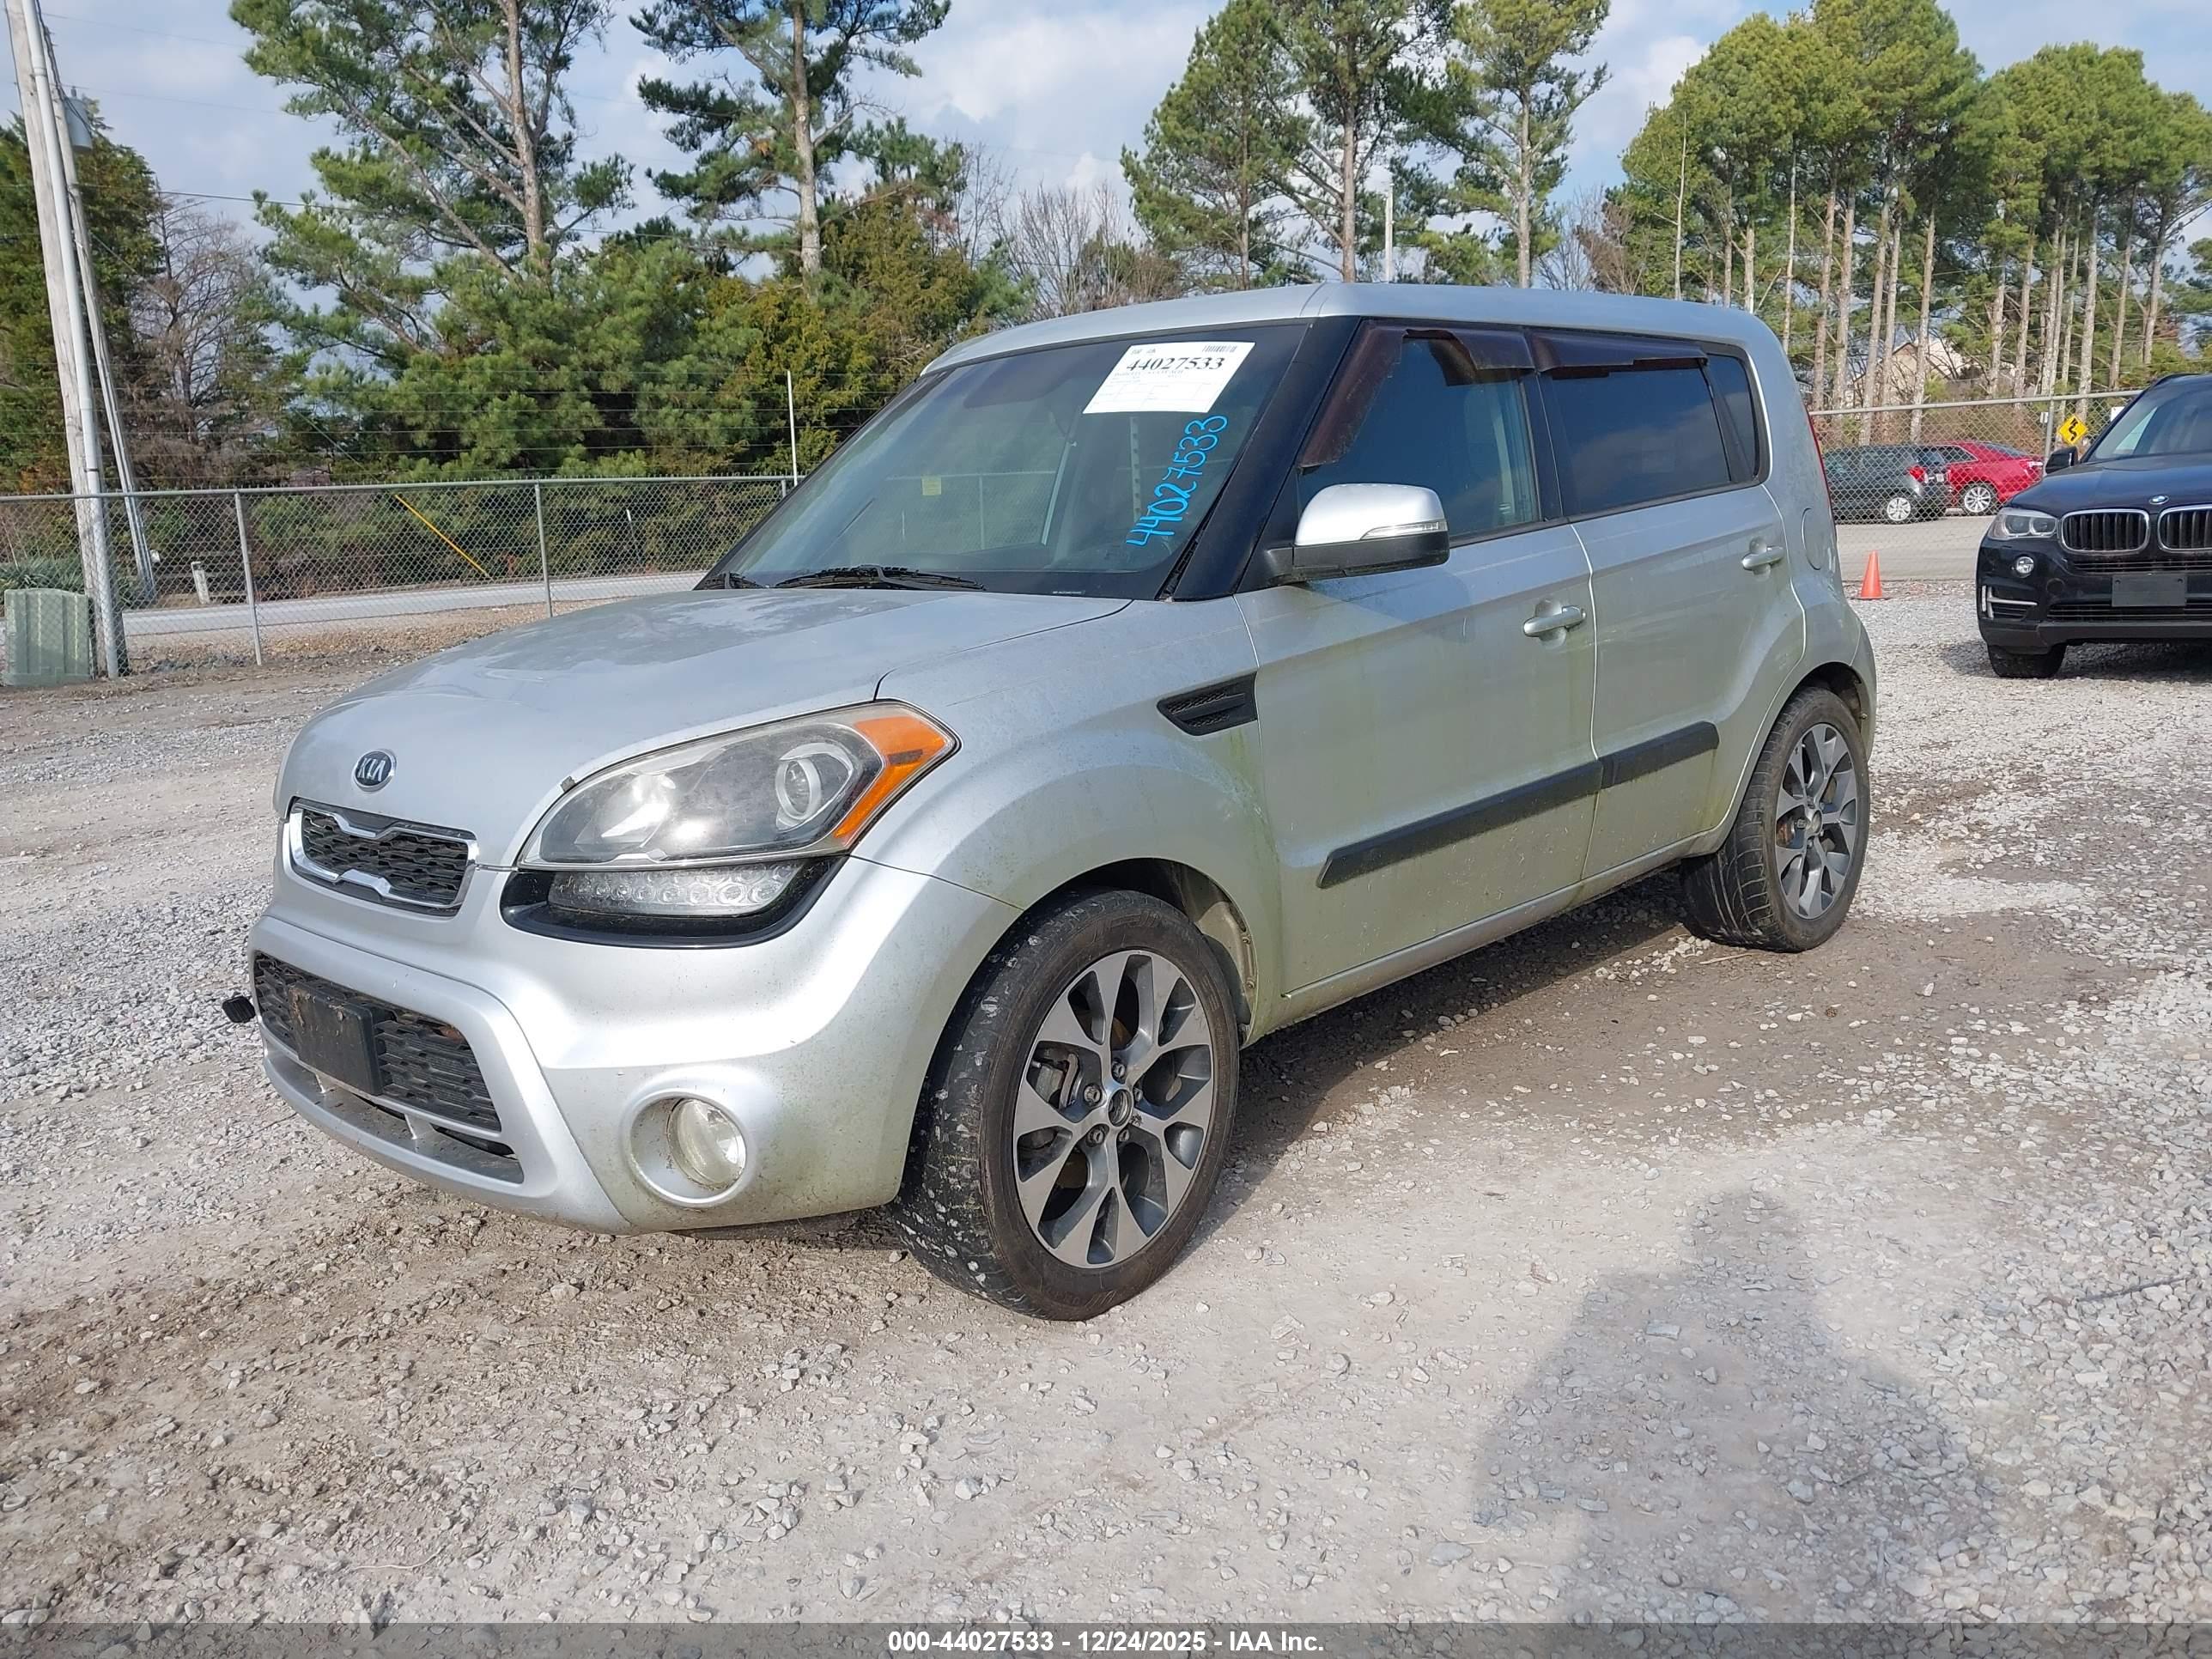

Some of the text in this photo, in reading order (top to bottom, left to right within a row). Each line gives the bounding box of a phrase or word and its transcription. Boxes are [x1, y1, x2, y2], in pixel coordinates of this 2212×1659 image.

[1127, 357, 1225, 371] 44027533
[1126, 416, 1228, 546] 44027533
[357, 757, 386, 781] KIA
